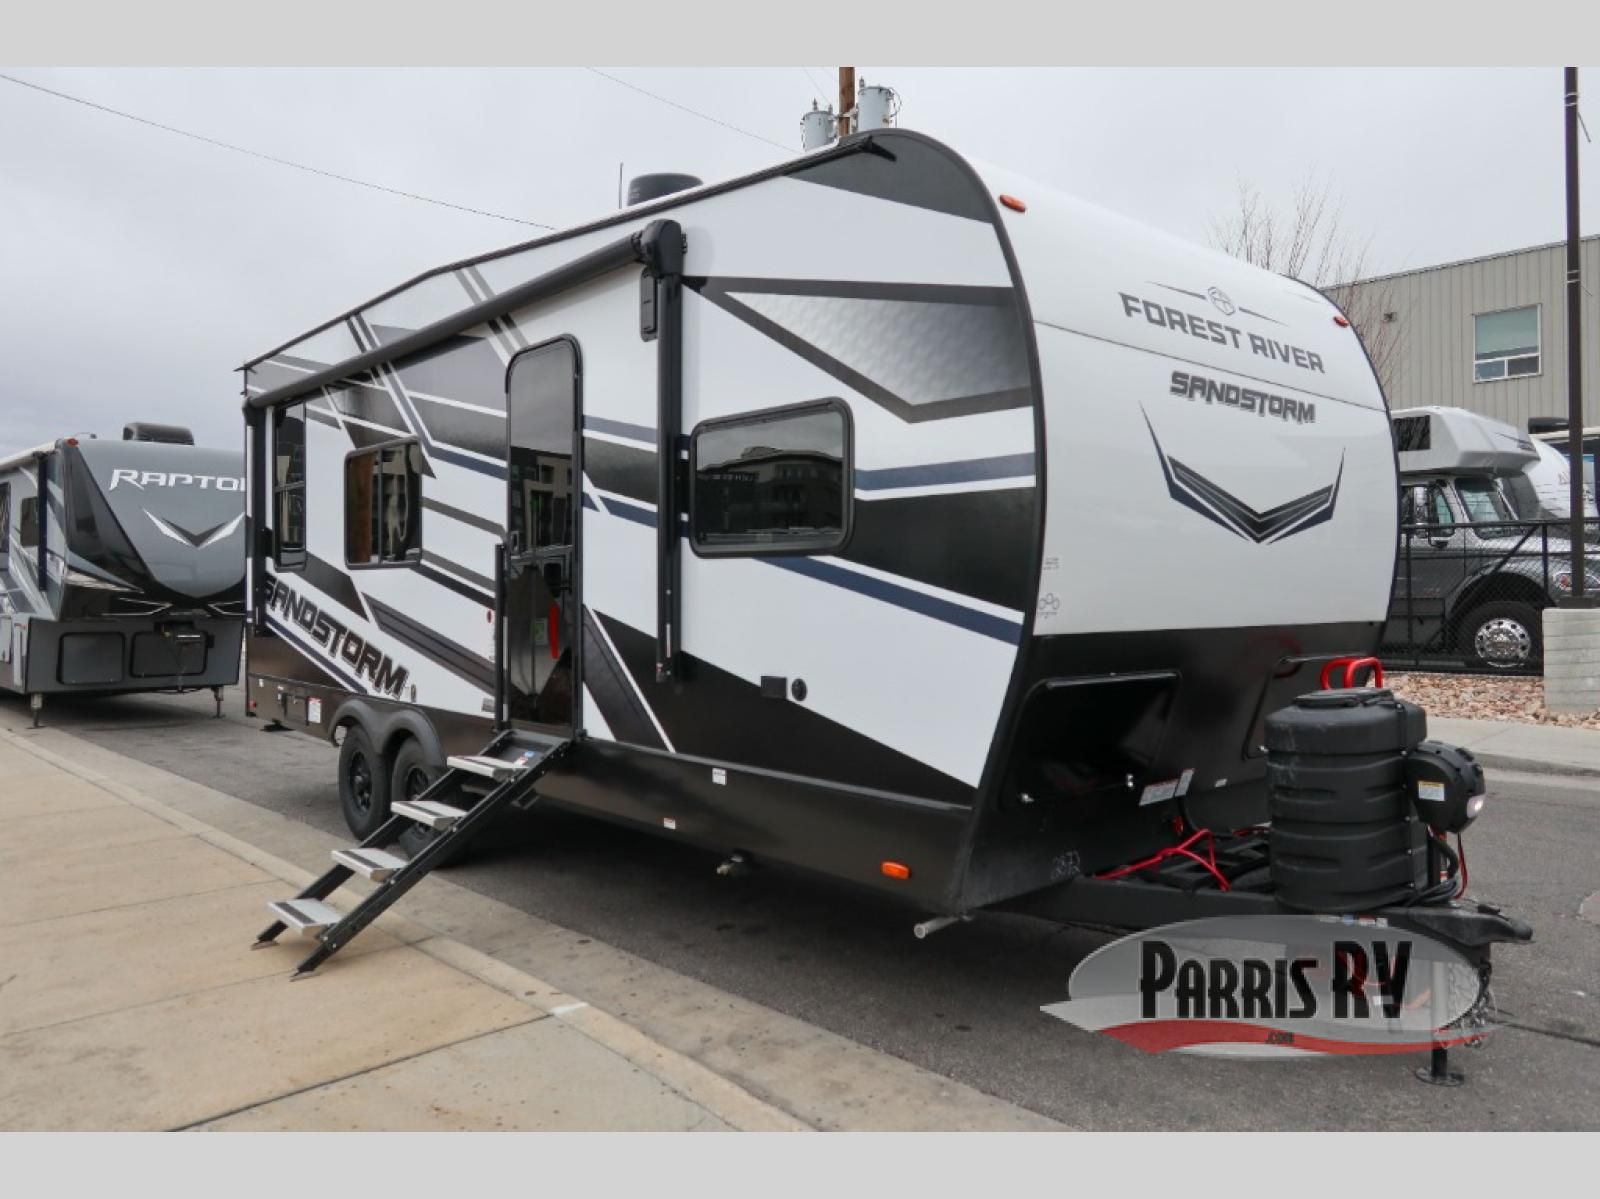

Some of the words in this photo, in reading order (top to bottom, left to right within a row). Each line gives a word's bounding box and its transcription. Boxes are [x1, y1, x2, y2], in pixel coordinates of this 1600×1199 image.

[1118, 292, 1241, 349] FOREST
[1247, 332, 1326, 373] RIVER
[1170, 370, 1316, 424] SANDSTORM
